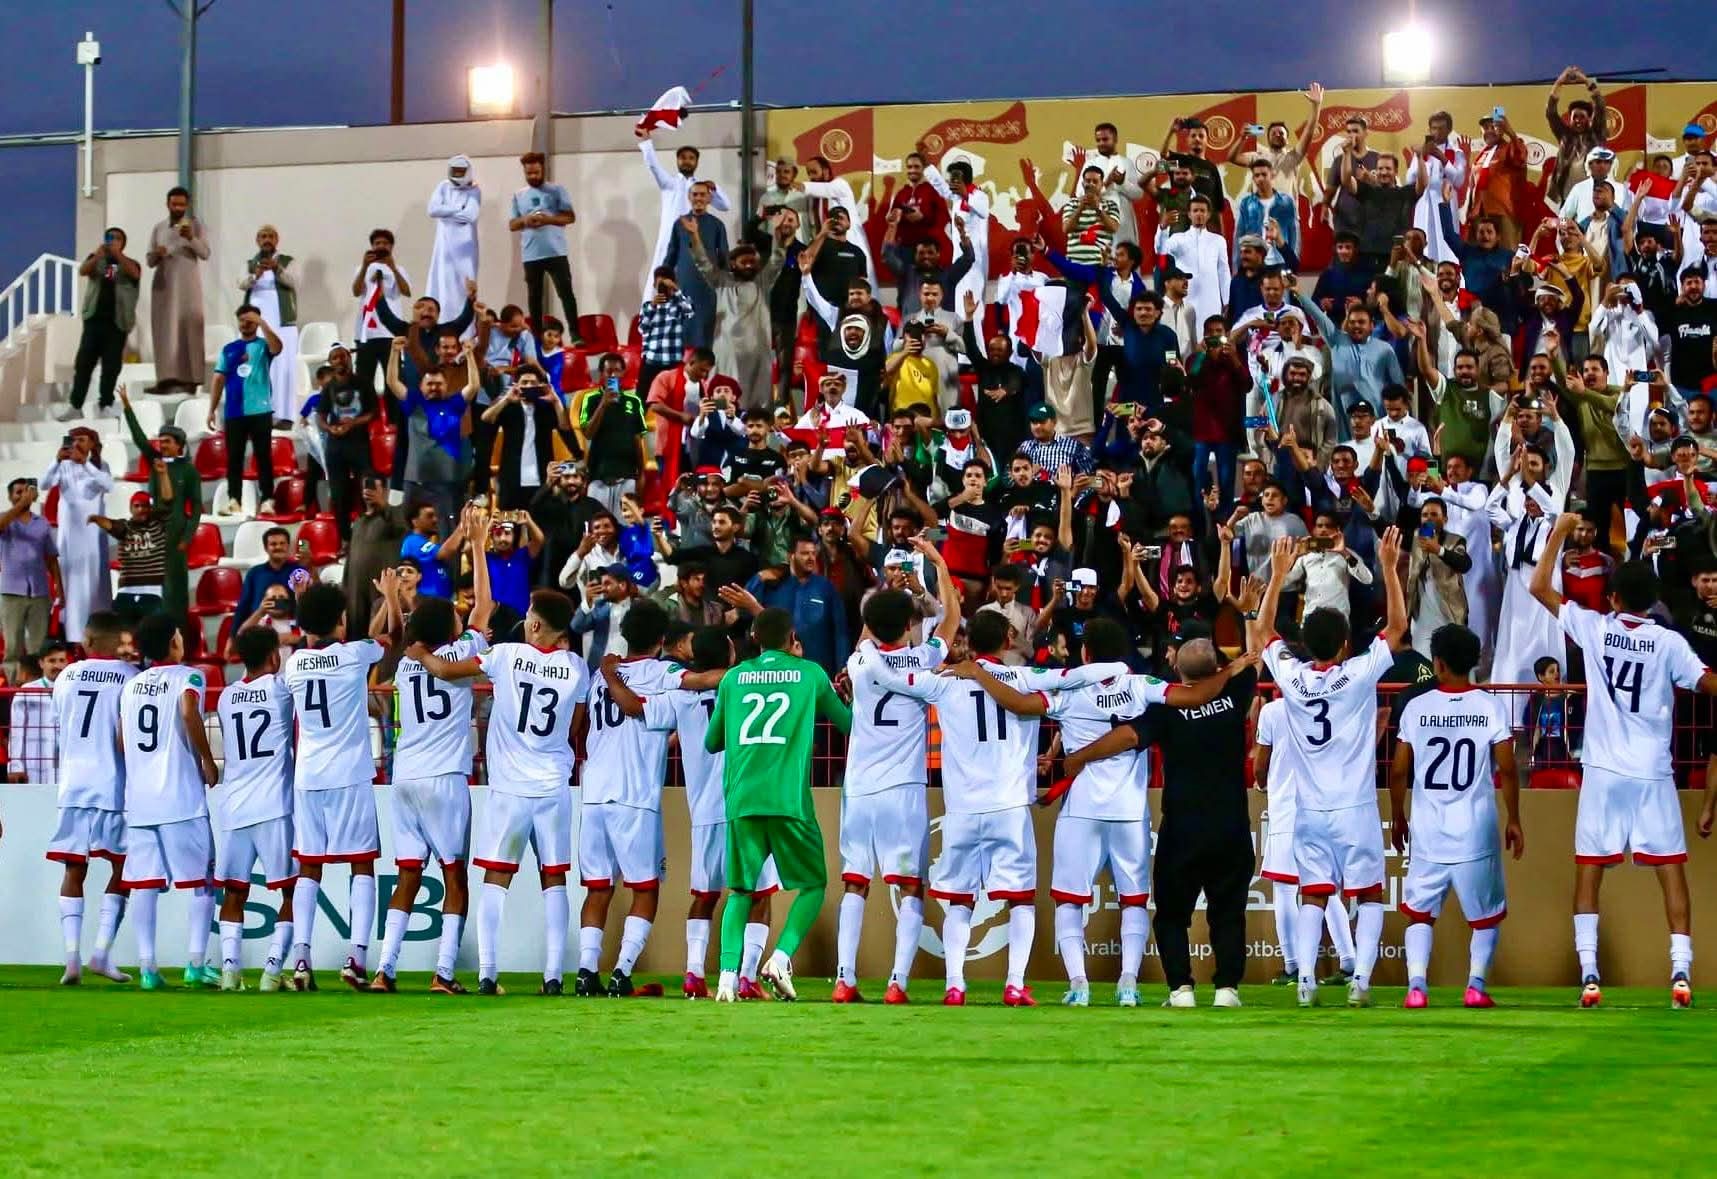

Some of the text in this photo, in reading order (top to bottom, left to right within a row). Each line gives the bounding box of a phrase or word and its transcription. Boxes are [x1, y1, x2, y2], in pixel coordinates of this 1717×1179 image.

[296, 655, 340, 671] HESHAM
[1604, 632, 1655, 653] BDULLAH
[409, 674, 452, 724] 15
[737, 670, 801, 685] MAHMOOD
[1096, 689, 1132, 709] AIMAN
[1603, 655, 1645, 713] 14
[78, 690, 99, 738] 7
[305, 679, 332, 728] 4
[517, 681, 559, 737] 13
[739, 692, 790, 745] 22
[970, 690, 1007, 742] 11
[1178, 696, 1234, 721] YEMEN
[1305, 698, 1332, 746] 3
[138, 704, 159, 752] 9
[231, 709, 275, 760] 12
[1424, 737, 1477, 791] 20
